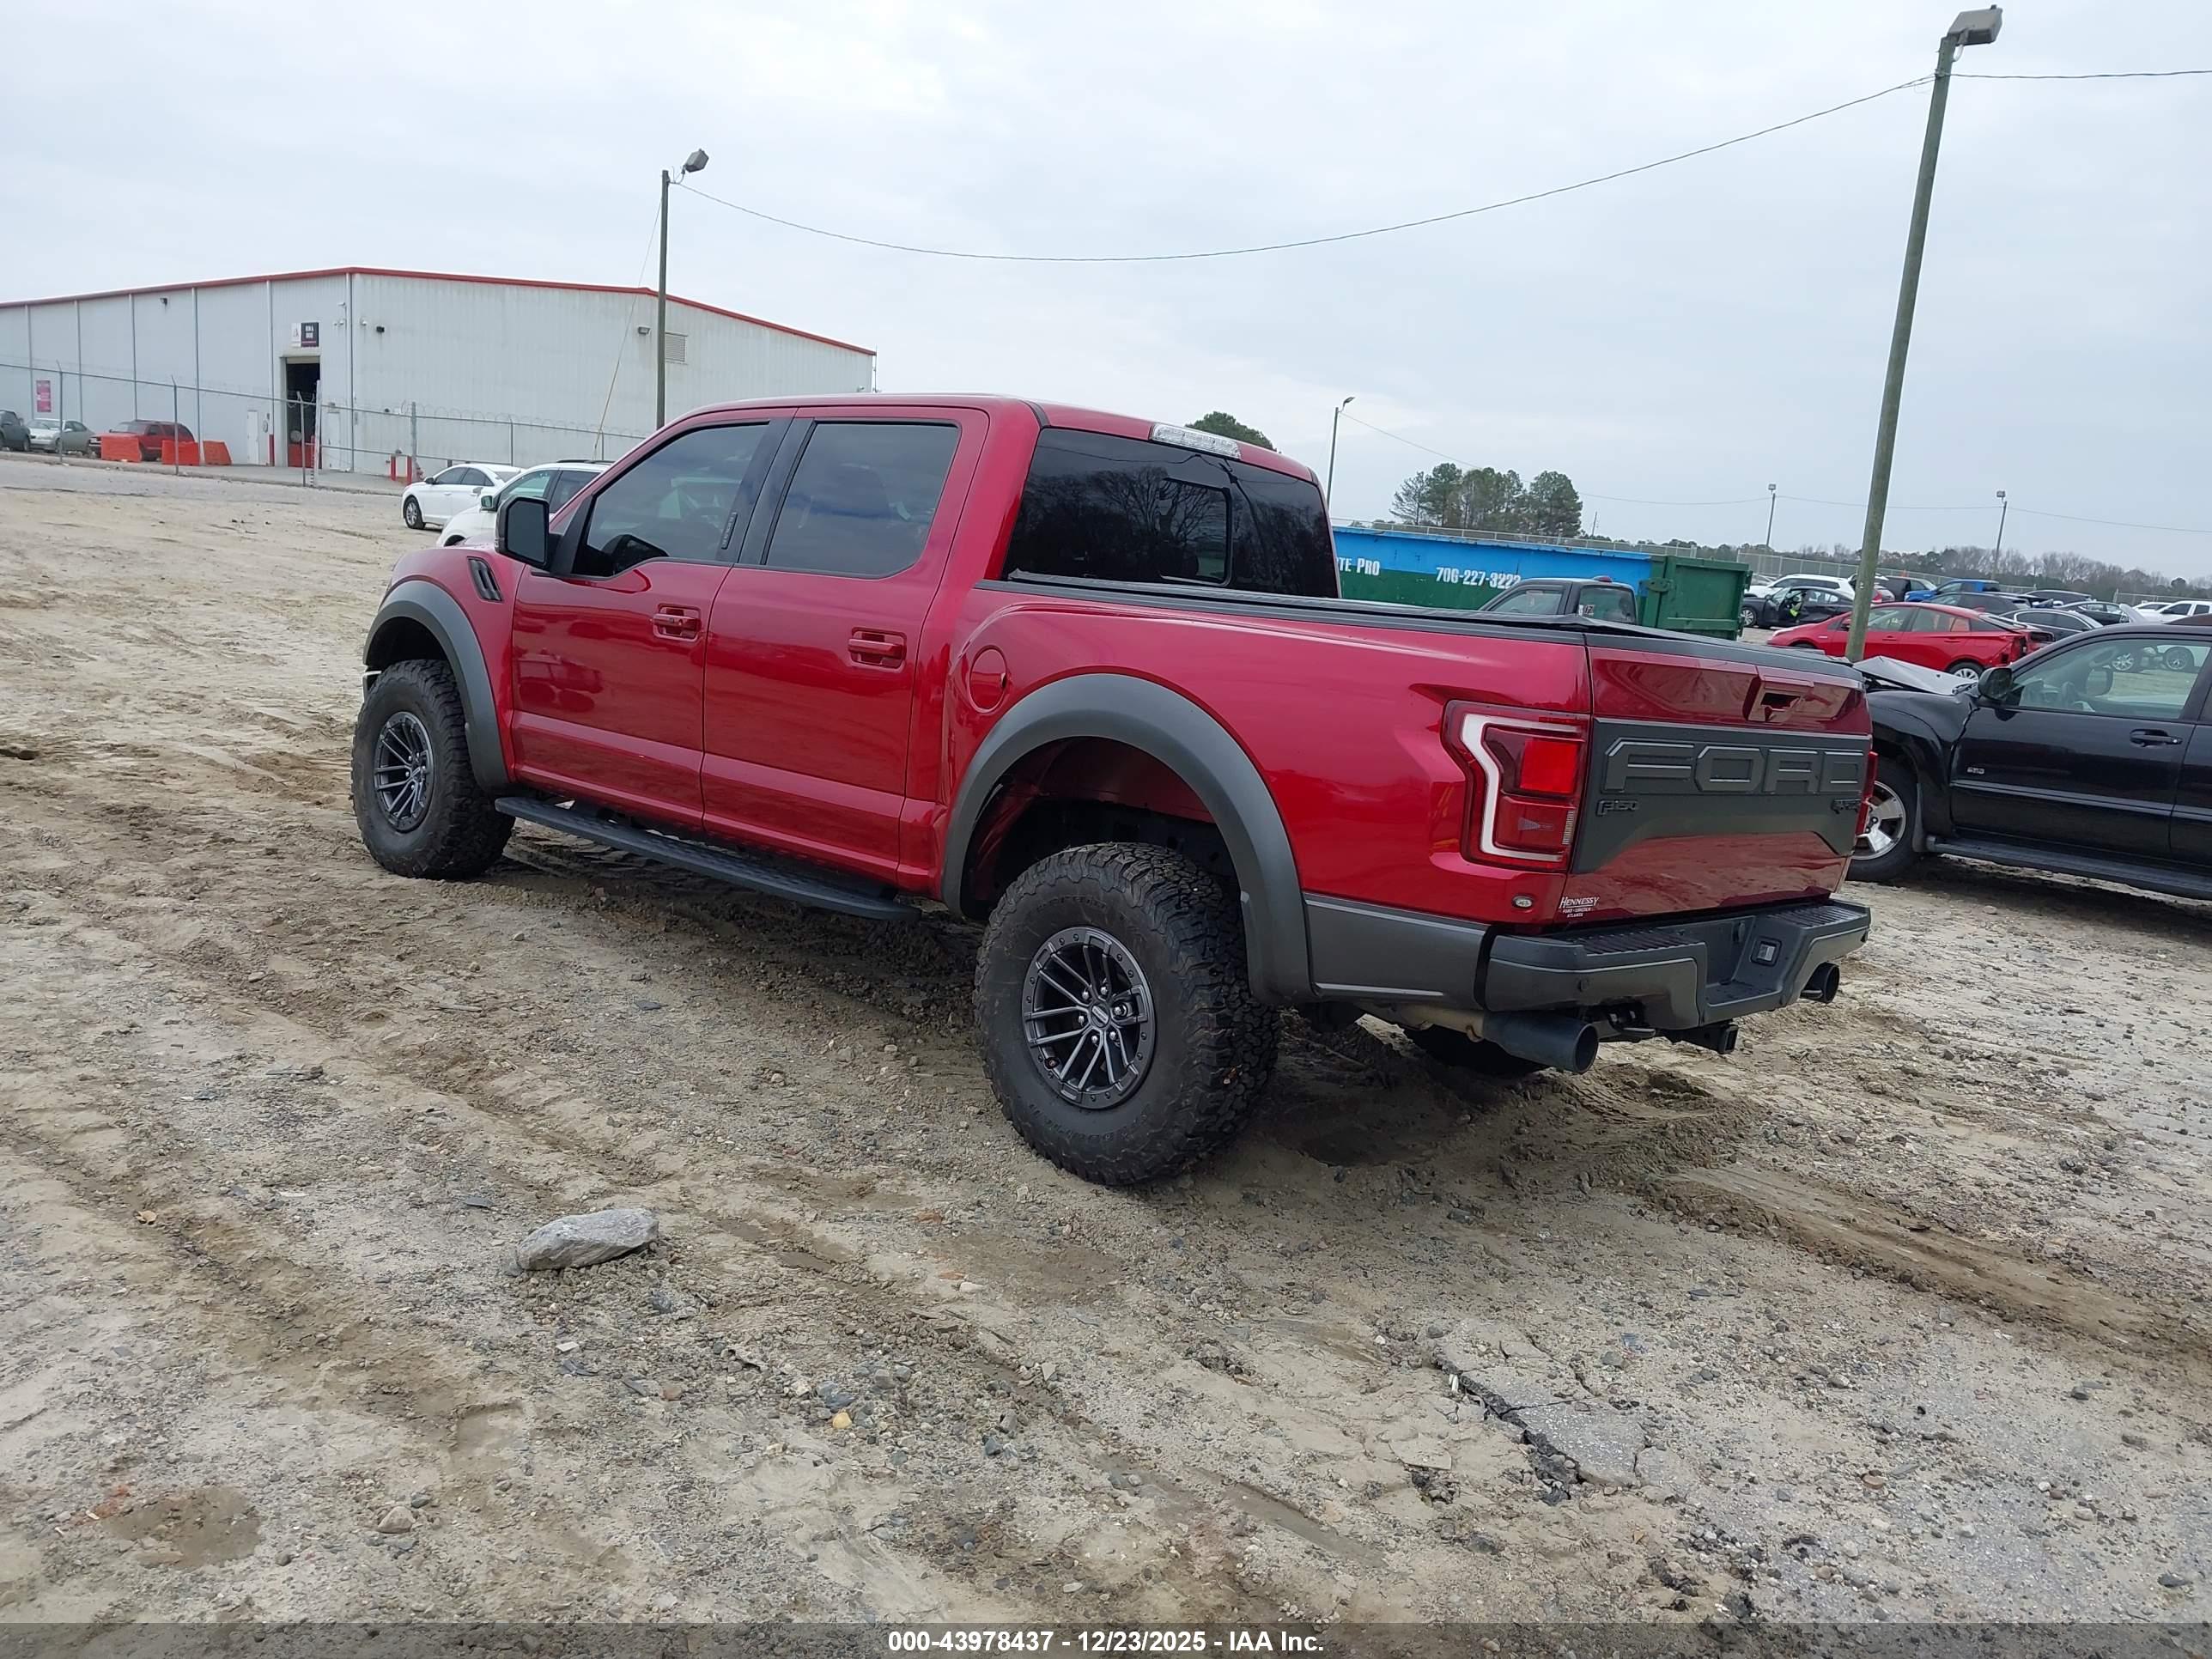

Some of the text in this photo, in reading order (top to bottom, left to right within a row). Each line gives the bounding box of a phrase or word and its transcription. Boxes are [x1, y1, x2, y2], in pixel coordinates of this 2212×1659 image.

[1336, 556, 1380, 576] TE PRO
[1602, 738, 1864, 793] FORD
[1559, 896, 1600, 908] HENNESSY
